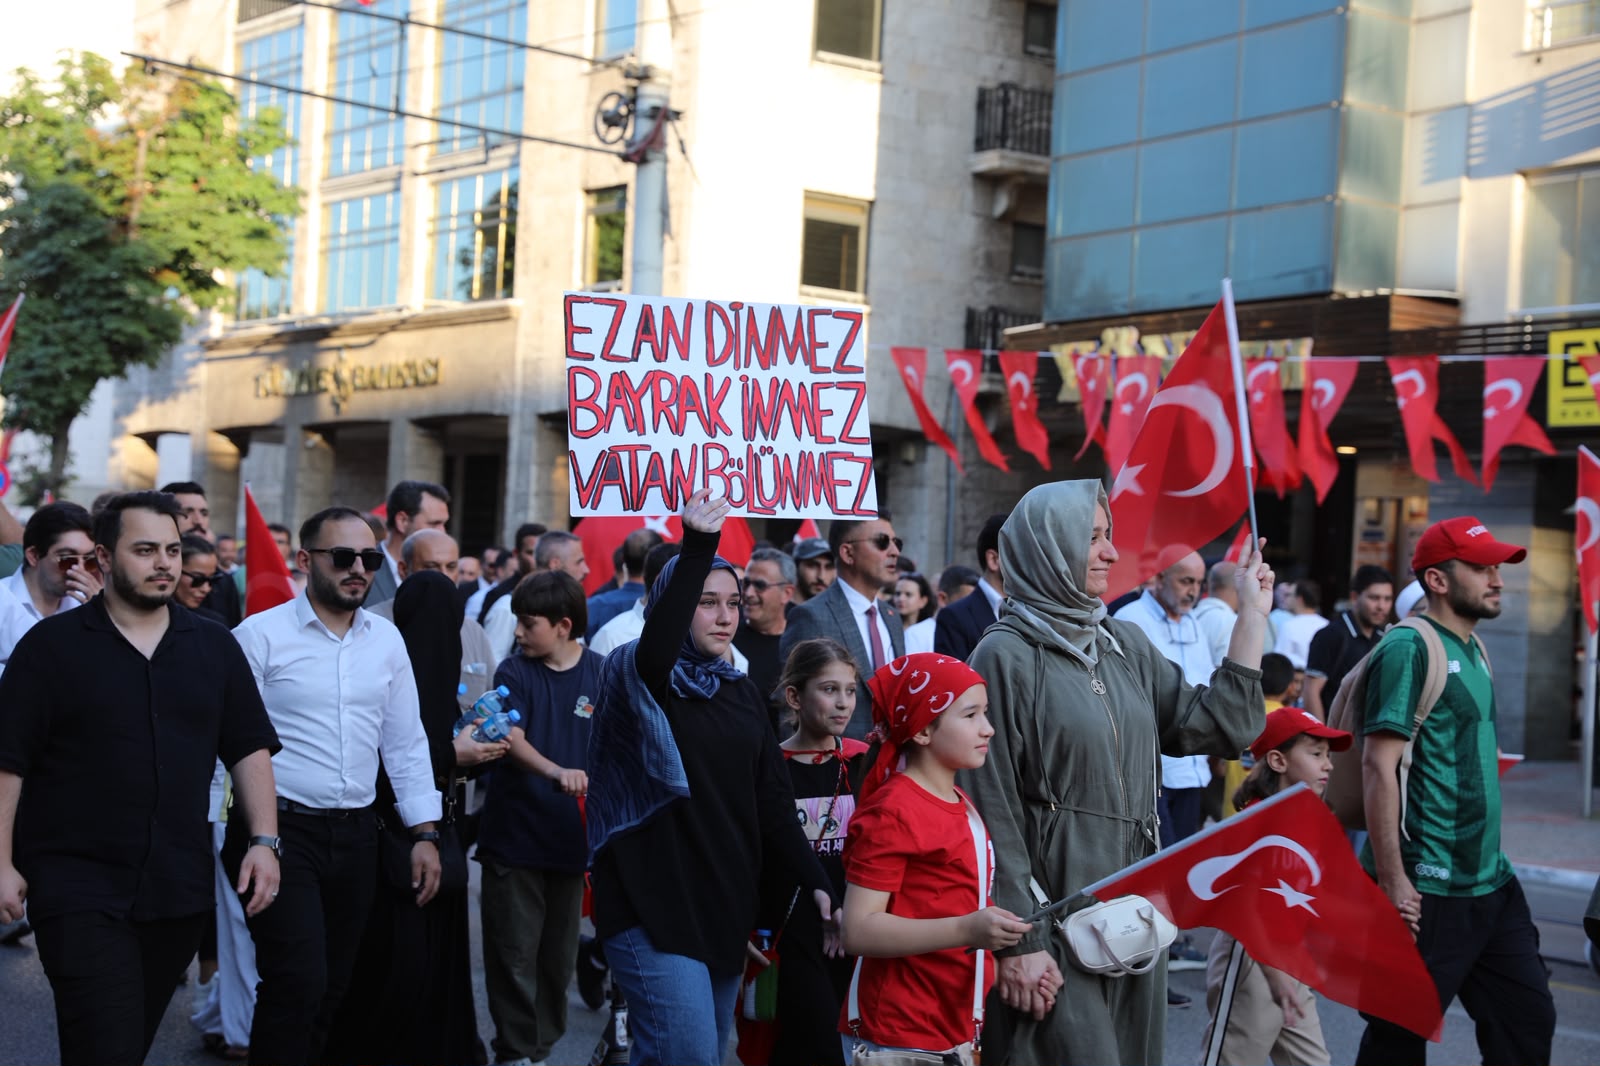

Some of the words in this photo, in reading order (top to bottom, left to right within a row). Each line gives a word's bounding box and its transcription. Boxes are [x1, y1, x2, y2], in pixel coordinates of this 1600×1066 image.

[564, 295, 693, 362] EZAN
[705, 300, 864, 374] DİNMEZ
[1563, 341, 1600, 387] E
[568, 366, 733, 439] BAYRAK
[739, 374, 870, 444] İNMEZ
[569, 443, 698, 511] VATAN
[702, 442, 878, 516] BÖLÜNMEZ
